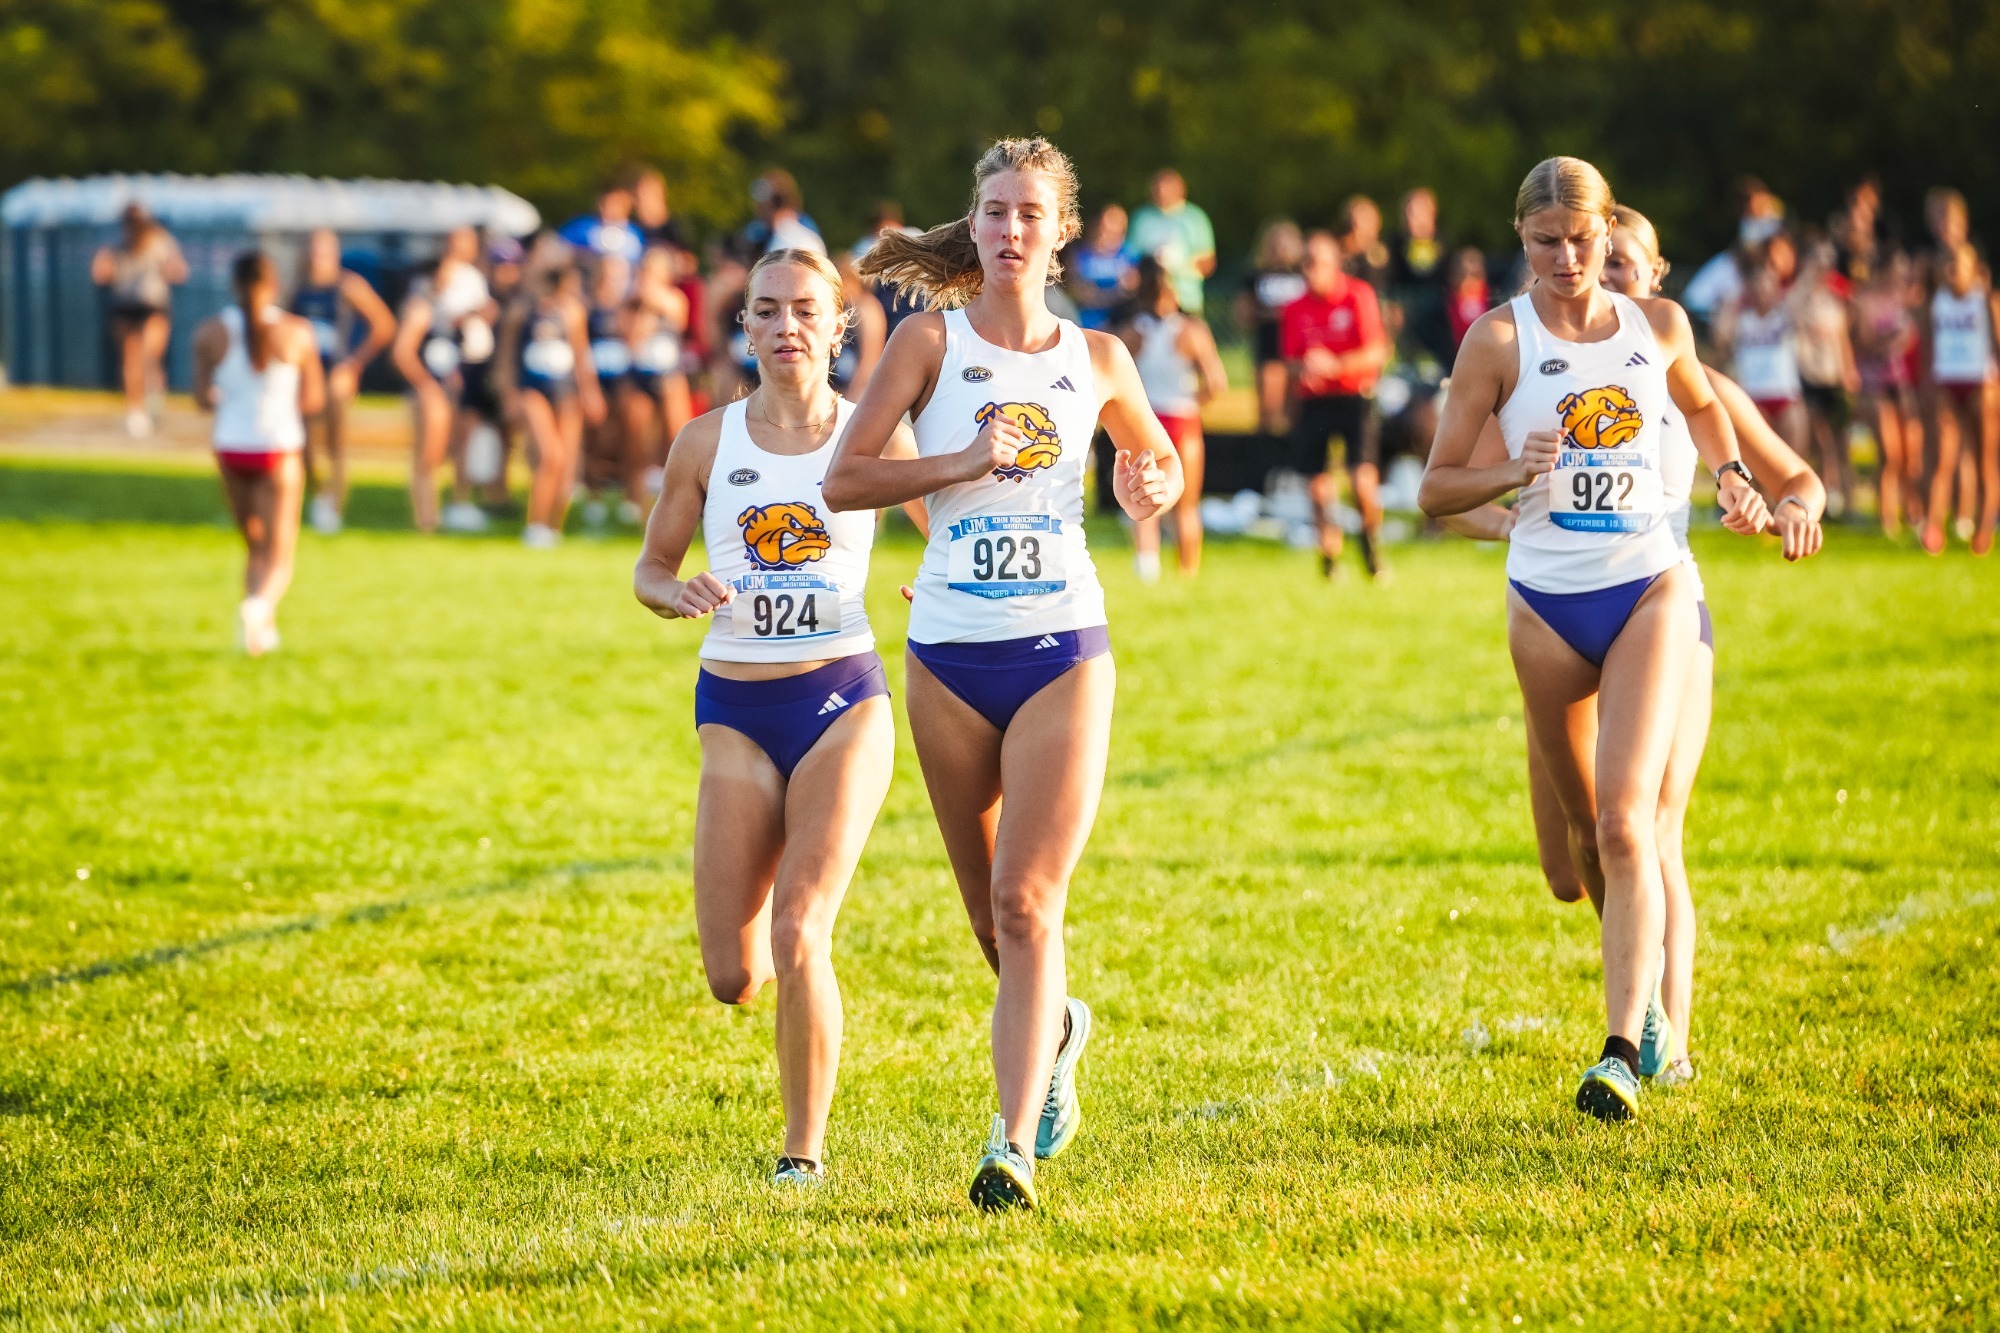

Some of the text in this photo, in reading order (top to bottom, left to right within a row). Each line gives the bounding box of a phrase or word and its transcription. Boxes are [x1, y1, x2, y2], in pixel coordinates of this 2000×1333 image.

[1567, 453, 1586, 466] JM
[1572, 472, 1634, 511] 922
[967, 517, 986, 534] JM
[991, 516, 1008, 524] JOHN
[1563, 518, 1606, 528] SEPTEMBER
[973, 536, 1042, 581] 923
[747, 575, 766, 589] JM
[754, 594, 819, 636] 924
